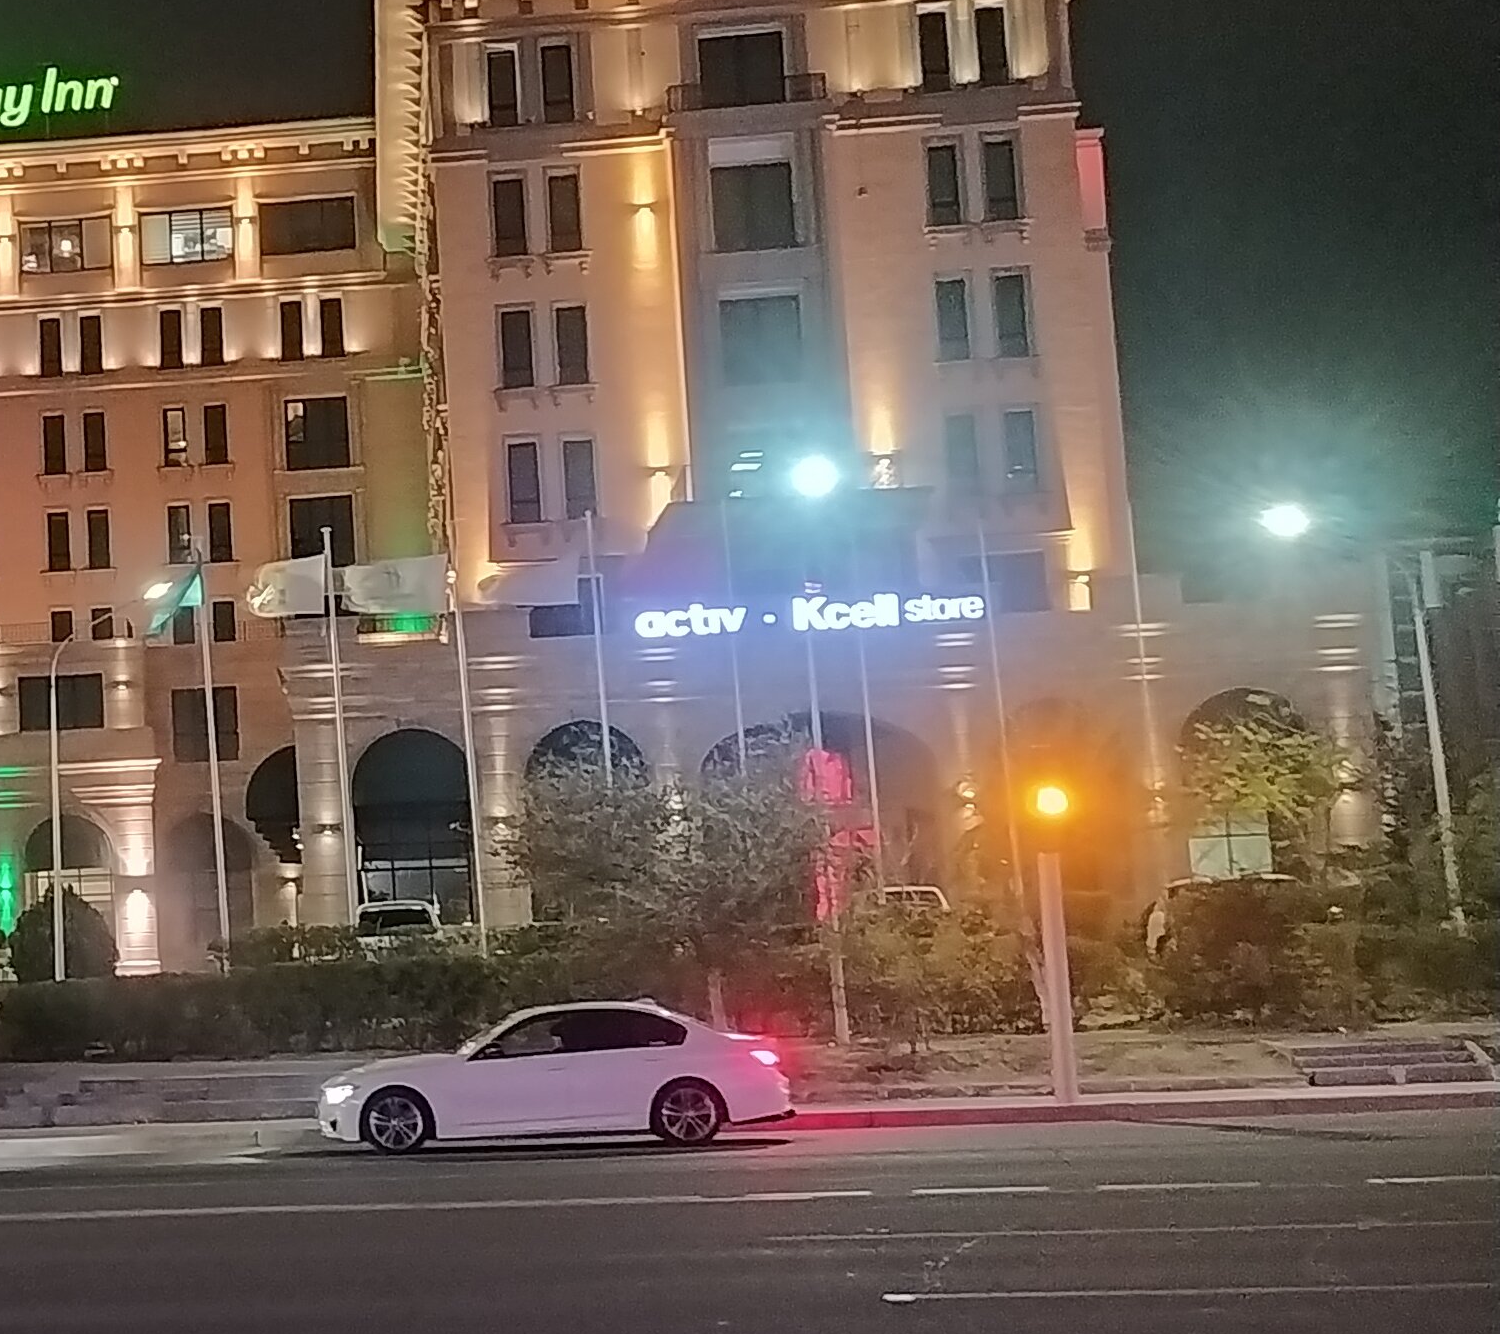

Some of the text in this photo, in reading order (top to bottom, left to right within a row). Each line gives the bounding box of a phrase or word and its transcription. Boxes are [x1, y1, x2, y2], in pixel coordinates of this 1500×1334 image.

[40, 67, 113, 114] Inn
[792, 593, 900, 631] Kcell
[904, 594, 985, 622] store
